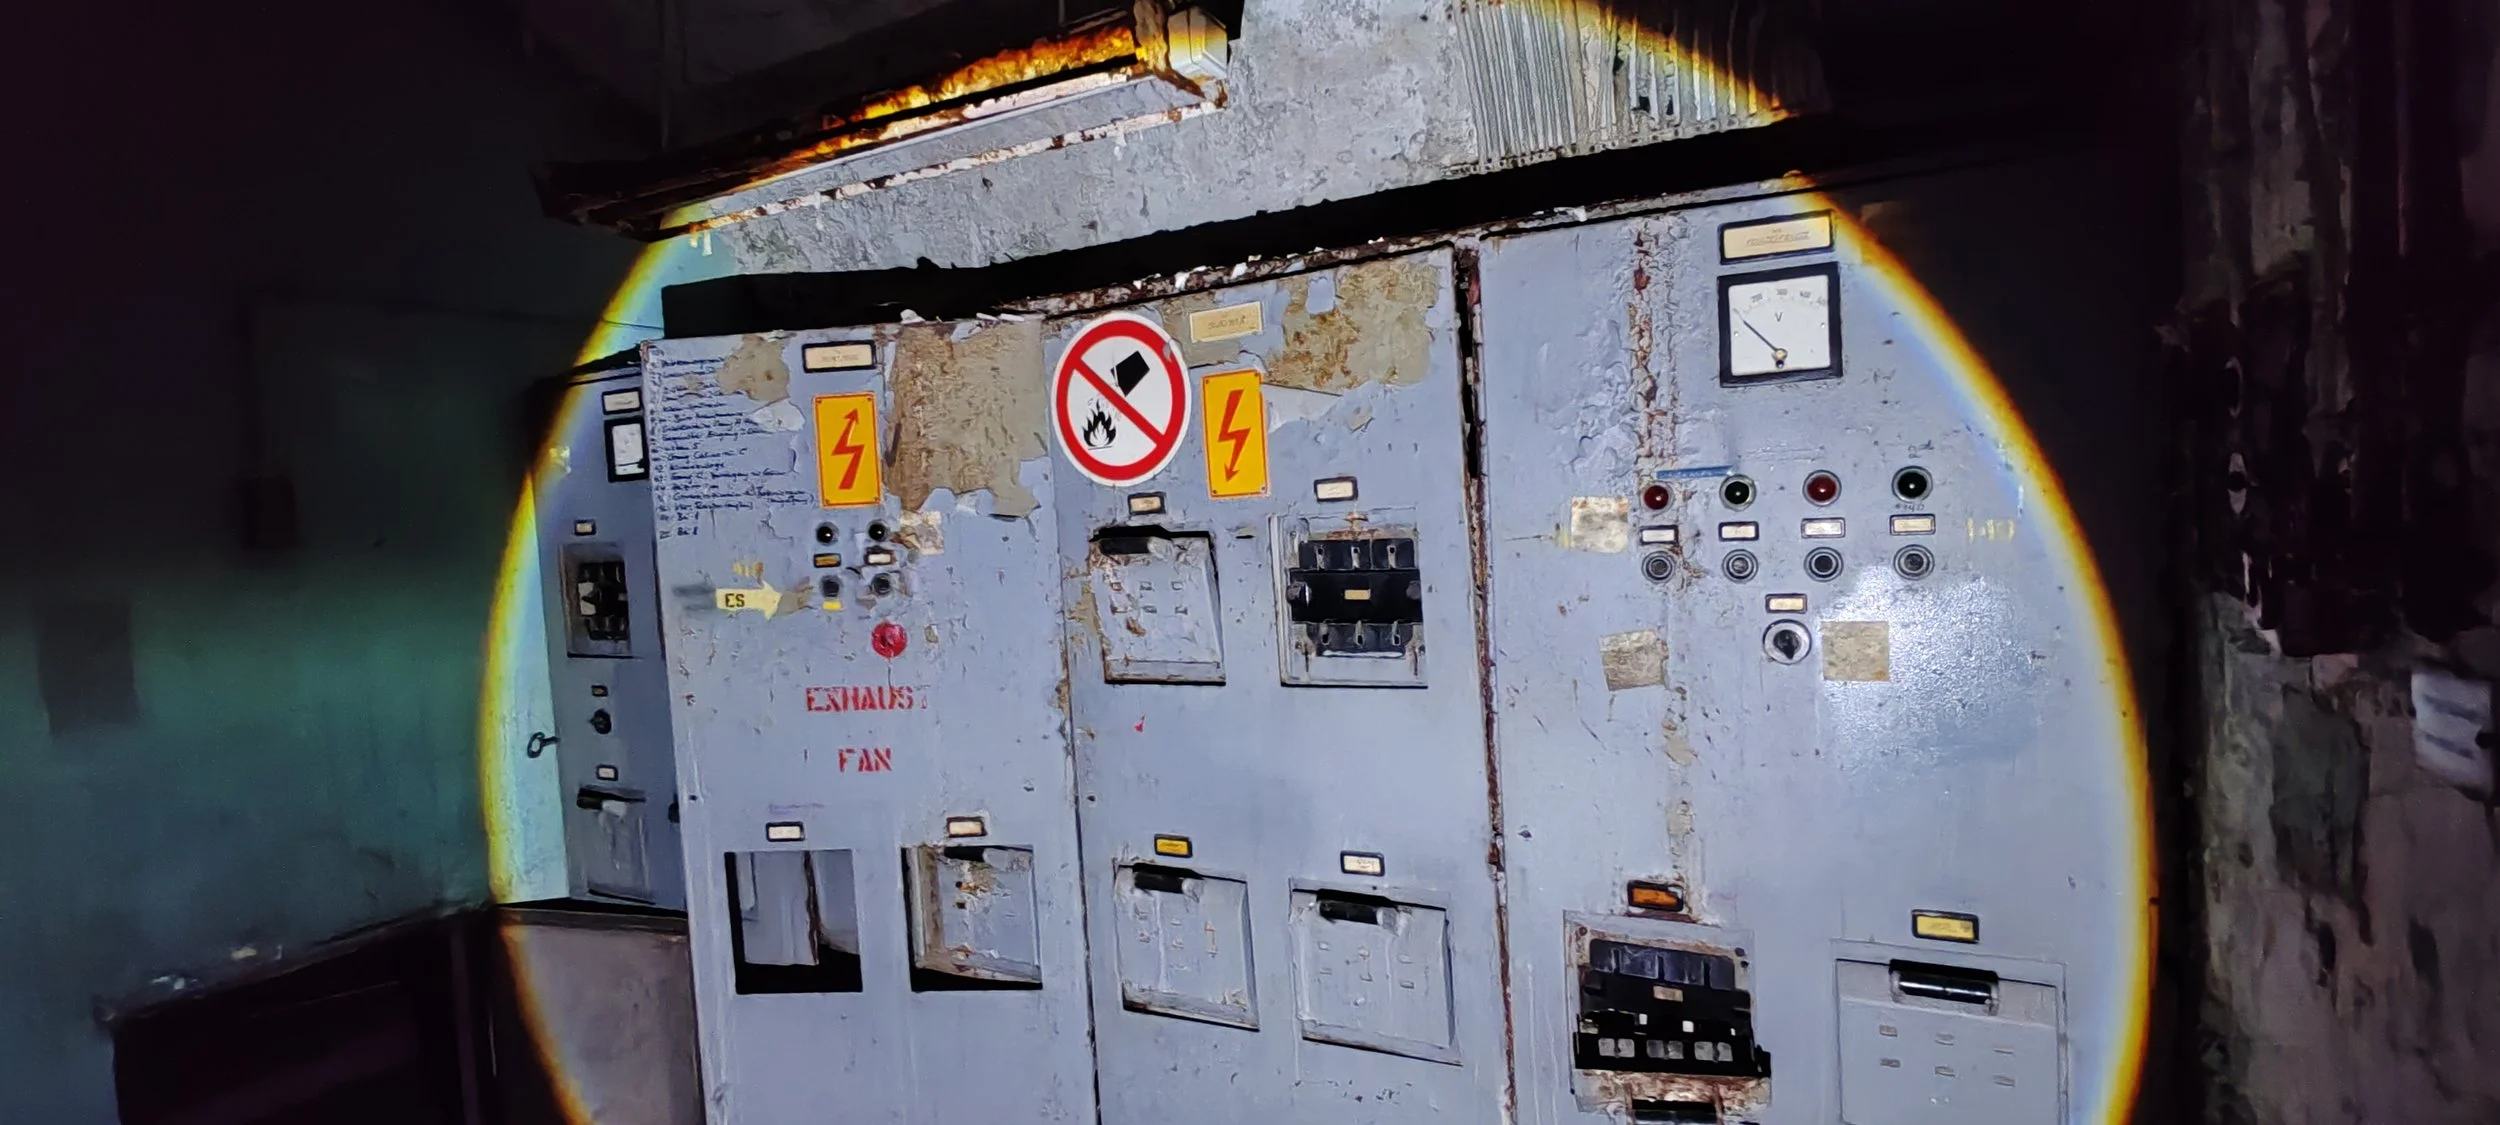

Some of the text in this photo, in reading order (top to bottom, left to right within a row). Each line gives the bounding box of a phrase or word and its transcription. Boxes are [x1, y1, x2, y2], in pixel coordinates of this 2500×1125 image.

[1775, 312, 1783, 322] V
[725, 593, 745, 608] ES
[838, 748, 892, 773] FAN
